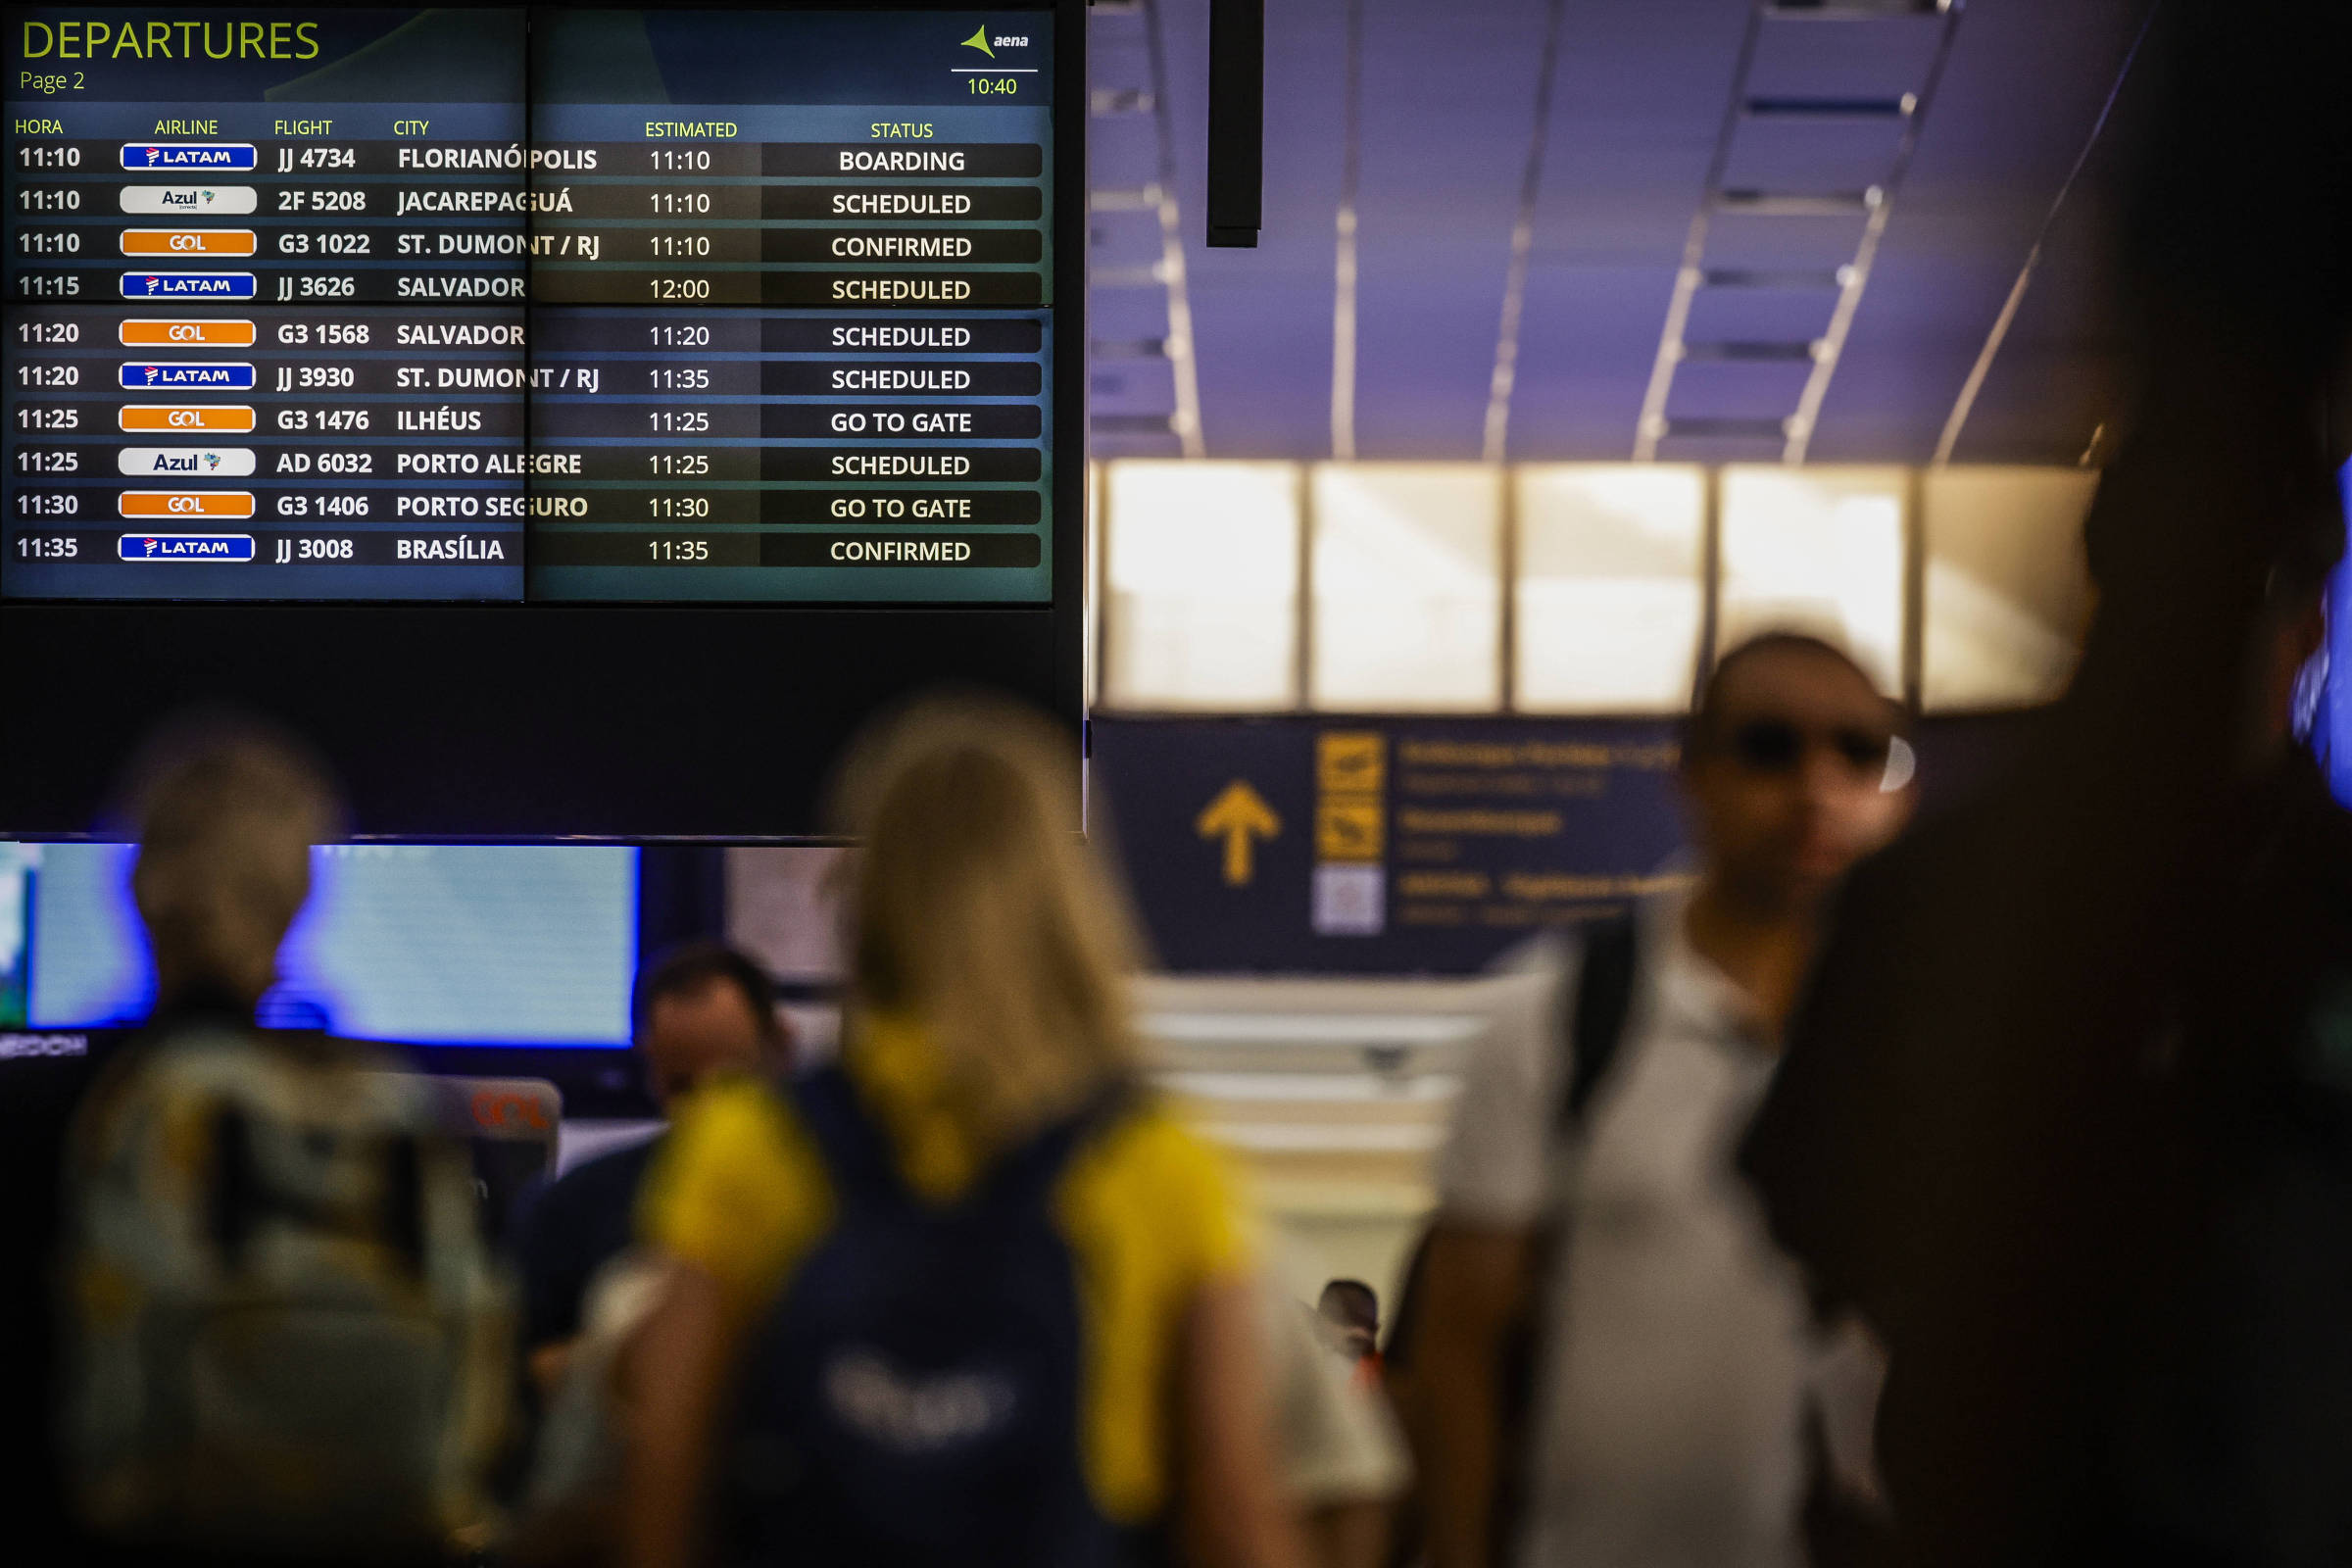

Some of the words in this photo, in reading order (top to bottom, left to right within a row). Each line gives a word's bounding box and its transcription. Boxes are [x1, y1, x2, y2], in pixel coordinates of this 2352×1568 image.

[24, 22, 319, 60] DEPARTURES
[994, 36, 1029, 47] aena
[20, 72, 68, 95] Page
[73, 72, 85, 89] 2
[968, 77, 1017, 95] 10:40
[16, 119, 64, 134] HORA
[154, 120, 218, 135] AIRLINE
[274, 120, 333, 135] FLIGHT
[393, 120, 429, 135] CITY
[646, 122, 738, 138] ESTIMATED
[870, 122, 934, 138] STATUS
[20, 147, 80, 167] 11:10
[164, 152, 230, 163] LATAM
[277, 148, 293, 173] JJ
[300, 147, 356, 168] 4734
[399, 143, 598, 170] FLORIANÓPOLIS
[650, 150, 710, 171] 11:10
[840, 151, 965, 172] BOARDING
[20, 189, 80, 210] 11:10
[162, 190, 197, 205] Azul
[278, 190, 306, 211] 2F
[312, 191, 367, 211] 5208
[396, 186, 573, 215] JACAREPAGUÁ
[650, 193, 710, 214] 11:10
[832, 194, 971, 214] SCHEDULED
[20, 232, 80, 253] 11:10
[170, 235, 206, 250] GOL
[278, 233, 310, 254] G3
[316, 233, 370, 254] 1022
[397, 233, 431, 254] ST.
[439, 234, 556, 256] DUMONT
[560, 235, 571, 256] /
[577, 235, 600, 261] RJ
[650, 236, 710, 256] 11:10
[831, 237, 972, 257] CONFIRMED
[19, 275, 79, 296] 11:15
[164, 279, 230, 291] LATAM
[276, 276, 293, 302] JJ
[300, 276, 355, 297] 3626
[397, 276, 525, 297] SALVADOR
[650, 279, 710, 299] 12:00
[832, 280, 971, 300] SCHEDULED
[19, 322, 79, 343] 11:20
[170, 325, 205, 340] GOL
[277, 323, 309, 344] G3
[315, 324, 370, 344] 1568
[397, 324, 525, 345] SALVADOR
[650, 325, 710, 346] 11:20
[832, 326, 971, 347] SCHEDULED
[18, 366, 79, 386] 11:20
[163, 370, 229, 381] LATAM
[275, 367, 292, 392] JJ
[299, 367, 355, 387] 3930
[396, 367, 430, 388] ST.
[438, 368, 555, 388] DUMONT
[560, 368, 571, 388] /
[577, 368, 599, 394] RJ
[650, 368, 710, 389] 11:35
[831, 369, 971, 390] SCHEDULED
[18, 409, 78, 428] 11:25
[169, 412, 205, 426] GOL
[277, 410, 309, 430] G3
[315, 410, 369, 430] 1476
[397, 405, 481, 431] ILHÉUS
[650, 412, 710, 432] 11:25
[831, 413, 866, 432] GO
[872, 413, 906, 432] TO
[911, 413, 972, 432] GATE
[18, 452, 78, 471] 11:25
[153, 454, 198, 471] Azul
[275, 453, 311, 473] AD
[318, 453, 372, 473] 6032
[397, 453, 479, 473] PORTO
[484, 454, 582, 474] ALEGRE
[649, 455, 710, 474] 11:25
[831, 456, 970, 475] SCHEDULED
[18, 494, 78, 514] 11:30
[168, 497, 204, 513] GOL
[276, 496, 308, 516] G3
[315, 496, 369, 516] 1406
[397, 496, 479, 516] PORTO
[485, 497, 588, 517] SEGURO
[649, 498, 710, 517] 11:30
[830, 499, 866, 517] GO
[871, 499, 905, 518] TO
[911, 499, 971, 518] GATE
[18, 537, 78, 558] 11:35
[162, 542, 229, 554] LATAM
[274, 539, 291, 564] JJ
[298, 538, 354, 559] 3008
[397, 534, 505, 560] BRASÍLIA
[649, 540, 709, 561] 11:35
[830, 541, 971, 562] CONFIRMED
